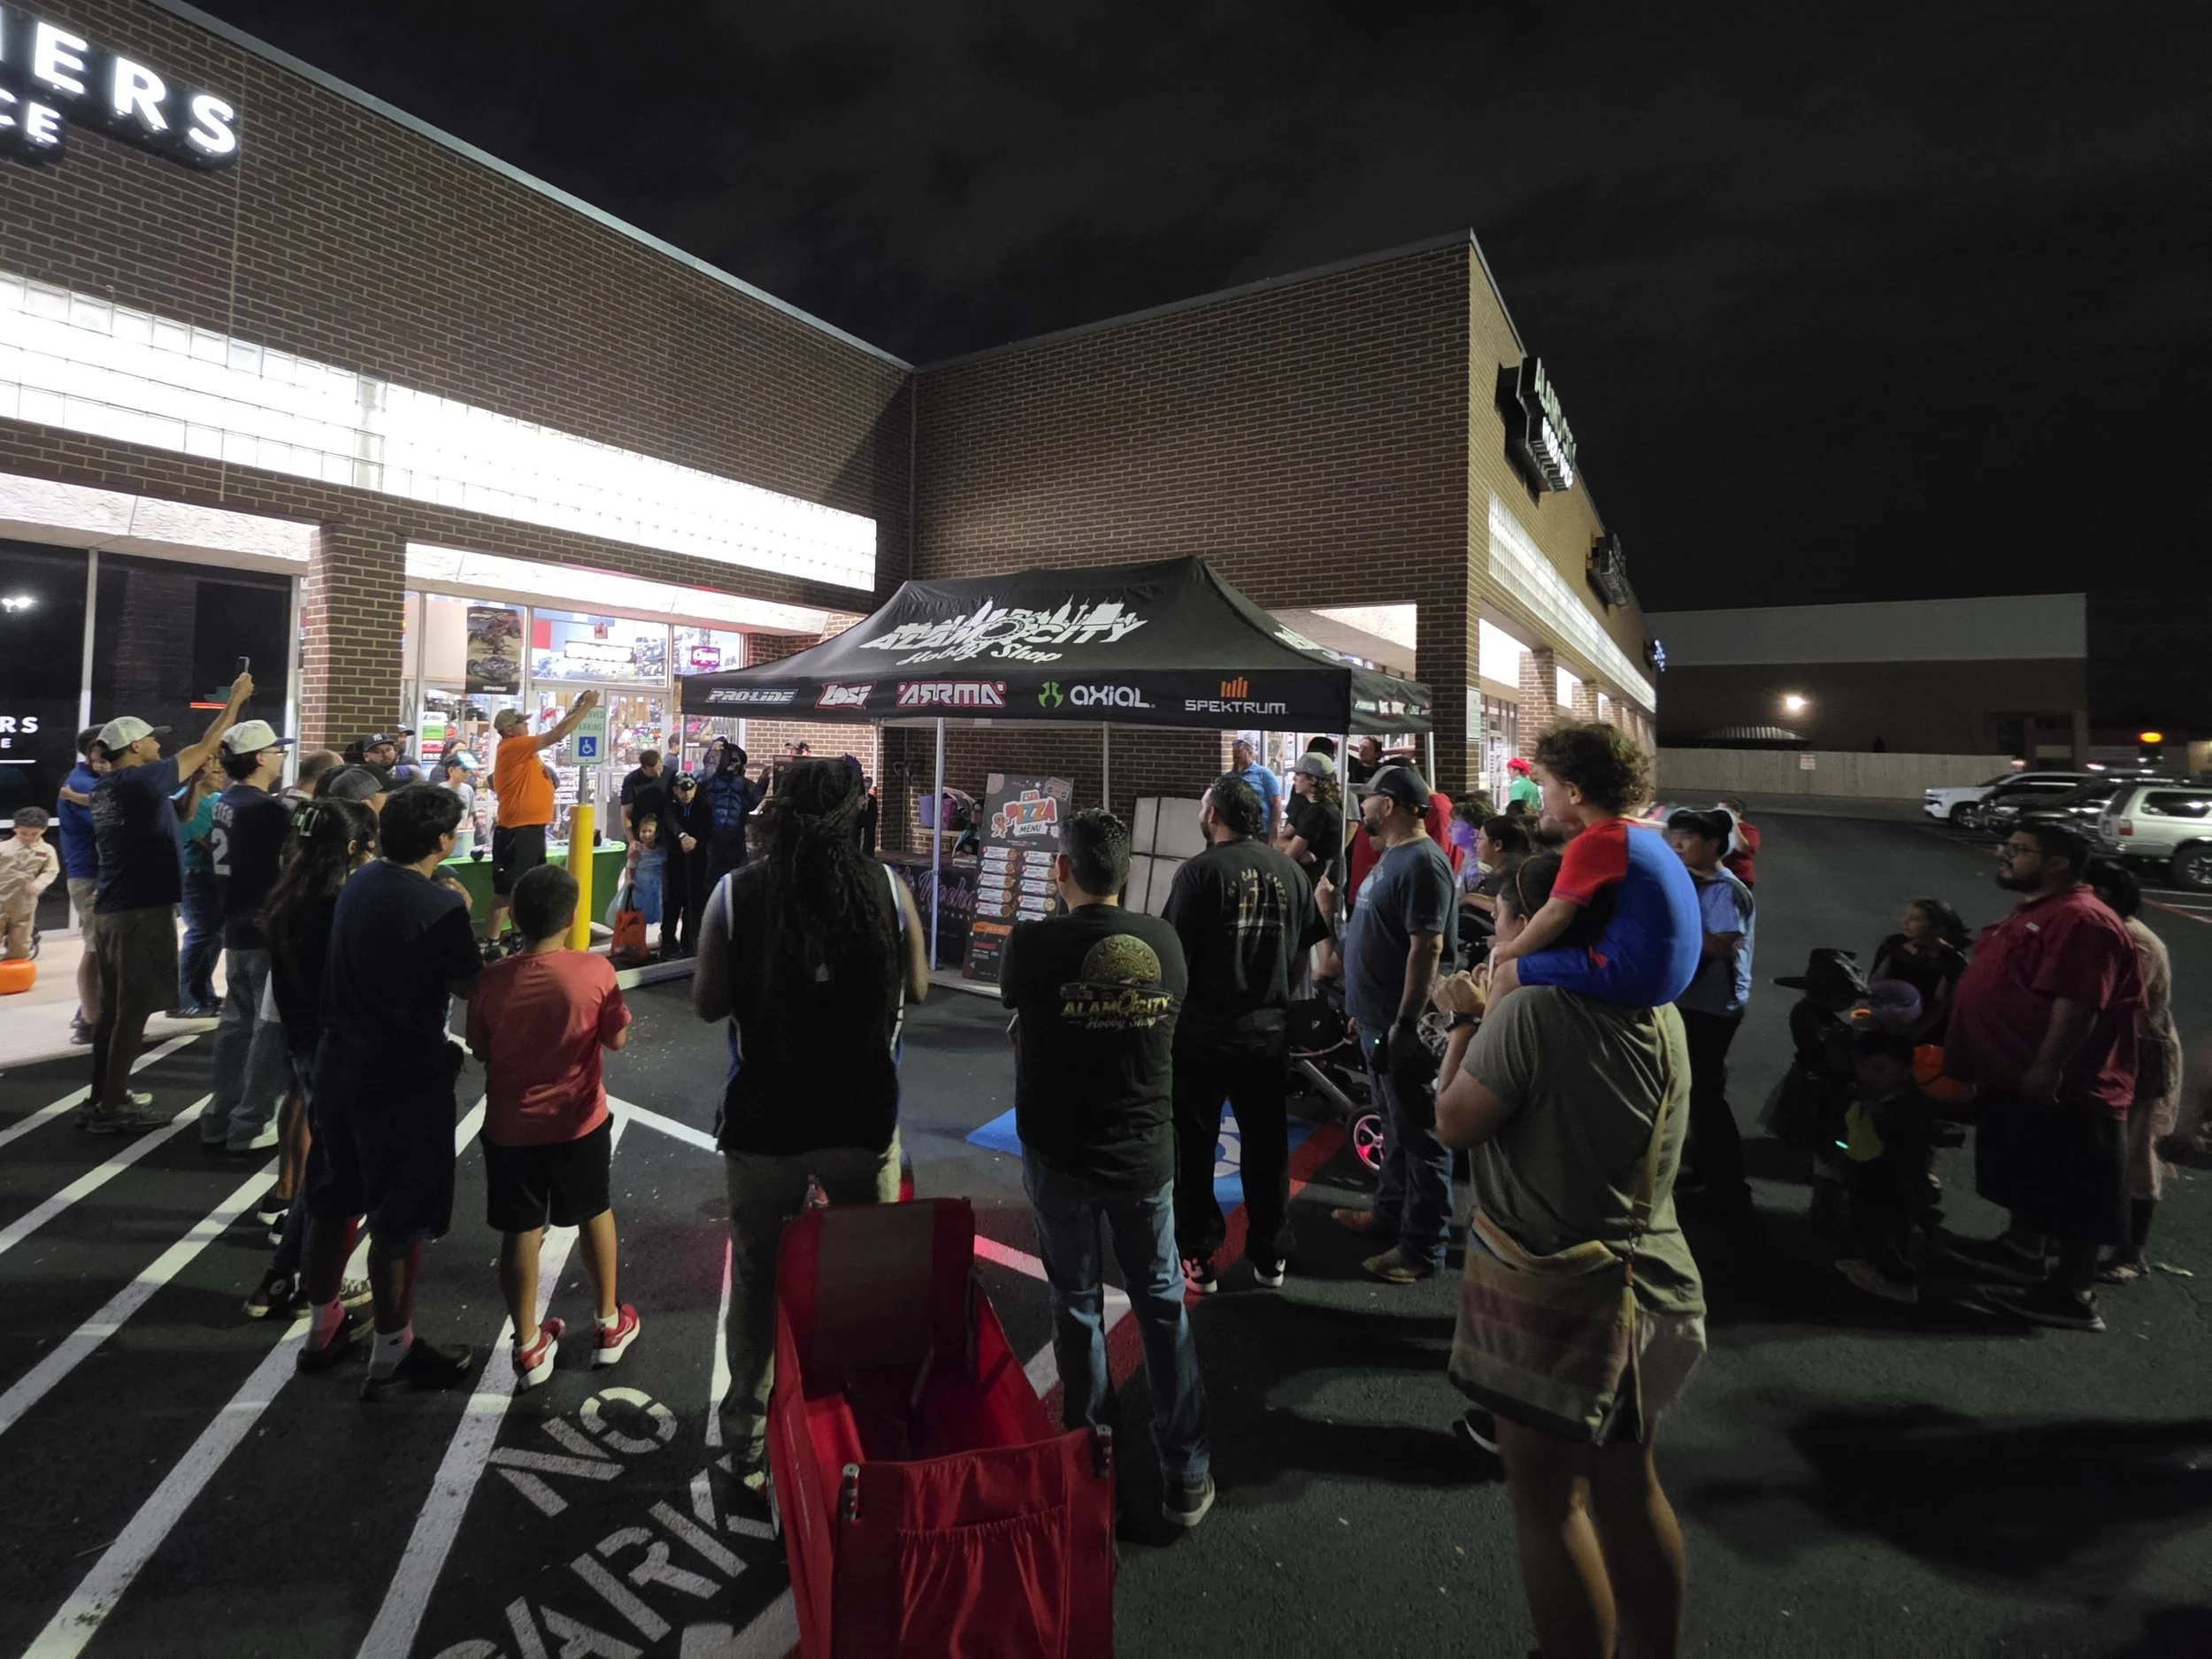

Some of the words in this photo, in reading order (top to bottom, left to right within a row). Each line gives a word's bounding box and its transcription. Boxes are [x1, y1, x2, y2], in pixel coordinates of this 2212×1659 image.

[0, 6, 237, 153] ERS
[896, 641, 984, 665] Hobby
[990, 642, 1062, 663] Shop
[1185, 699, 1286, 715] SPEKTRUM
[1005, 798, 1056, 825] PIZZA
[1018, 824, 1042, 833] MENU
[211, 827, 232, 876] 2
